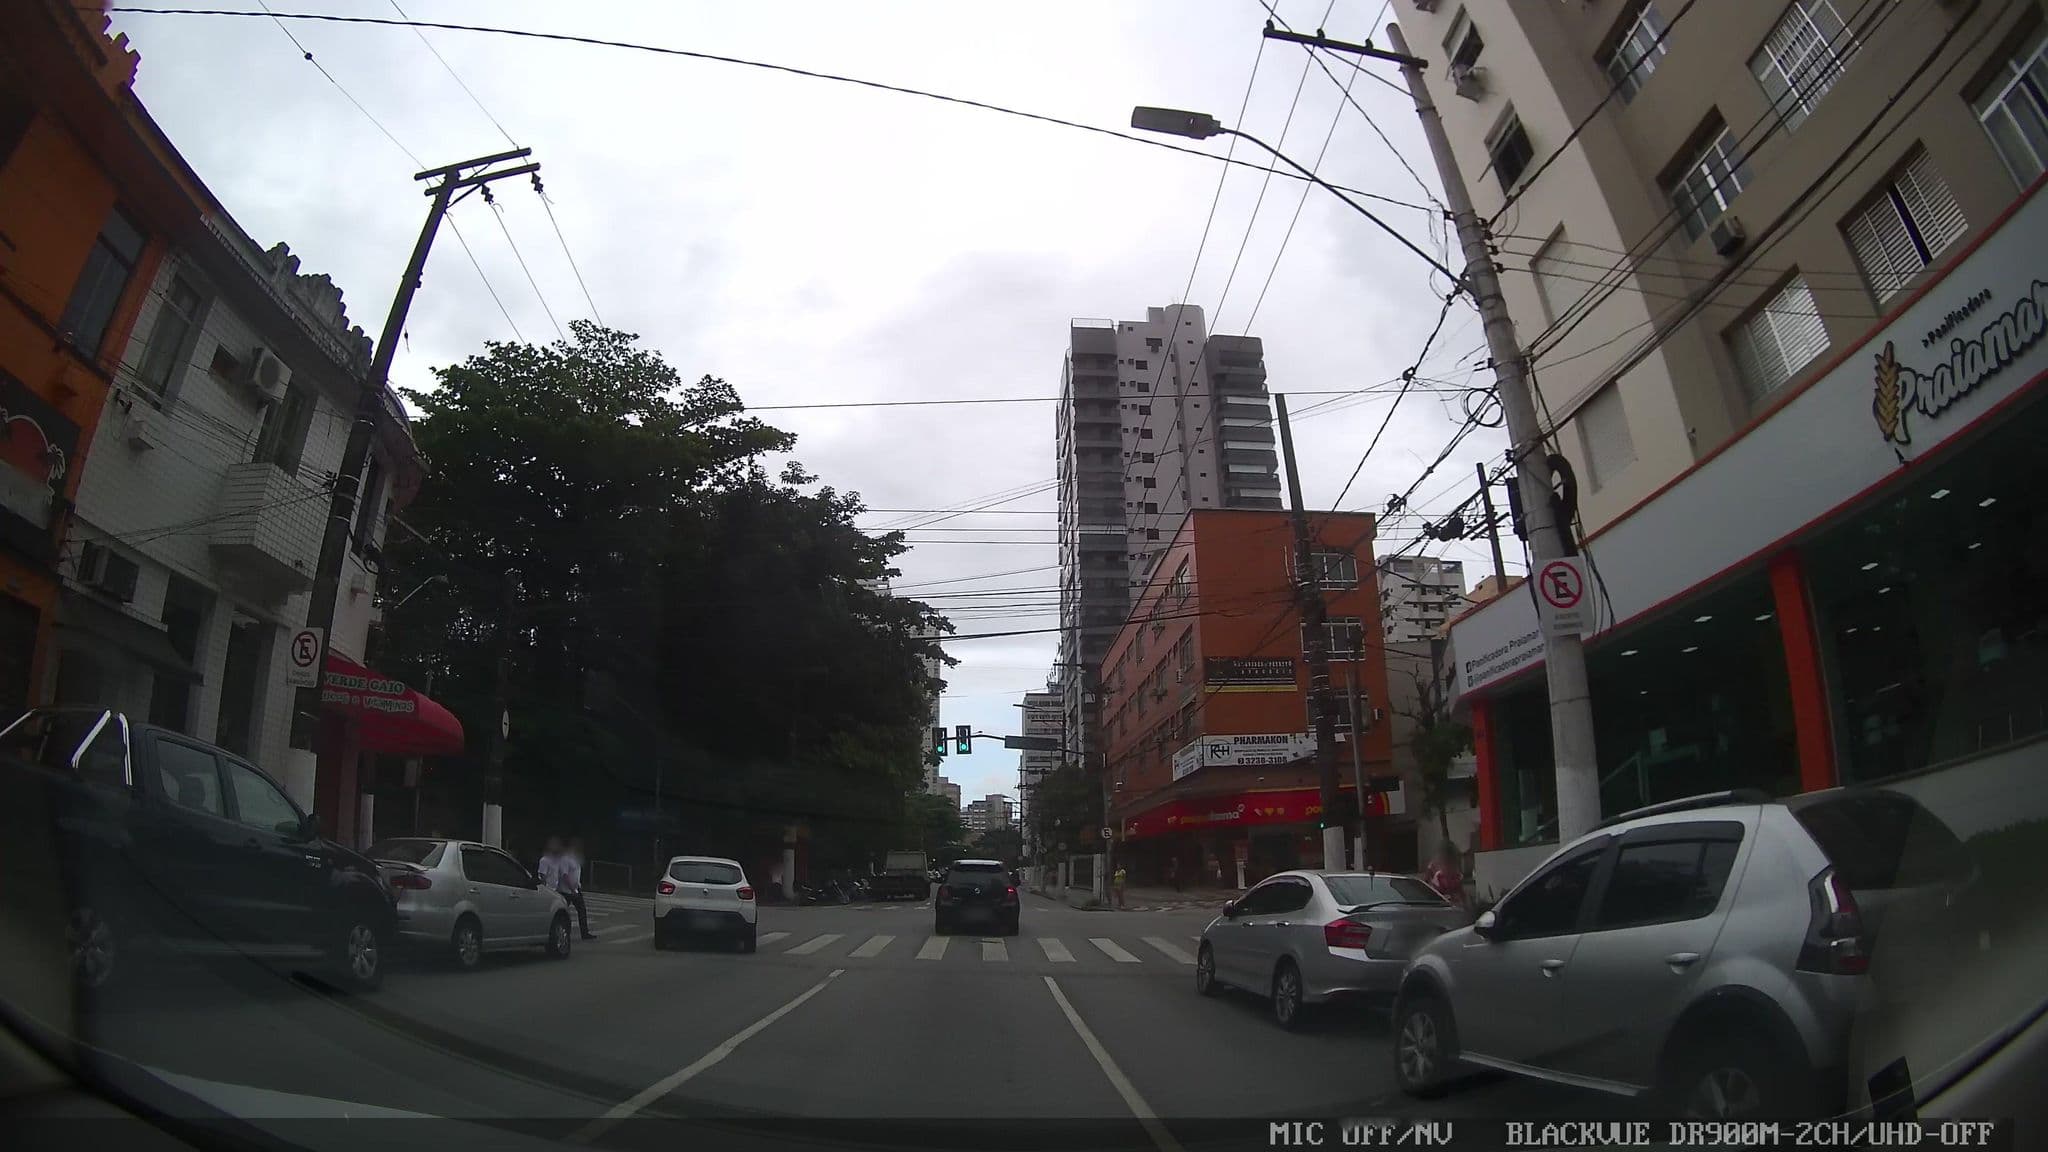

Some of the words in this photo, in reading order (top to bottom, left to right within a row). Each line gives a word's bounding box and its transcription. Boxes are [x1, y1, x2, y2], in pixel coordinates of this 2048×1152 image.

[1472, 645, 1509, 668] Panificadora
[369, 679, 405, 695] GAIO
[1233, 735, 1288, 745] PHARMAKON
